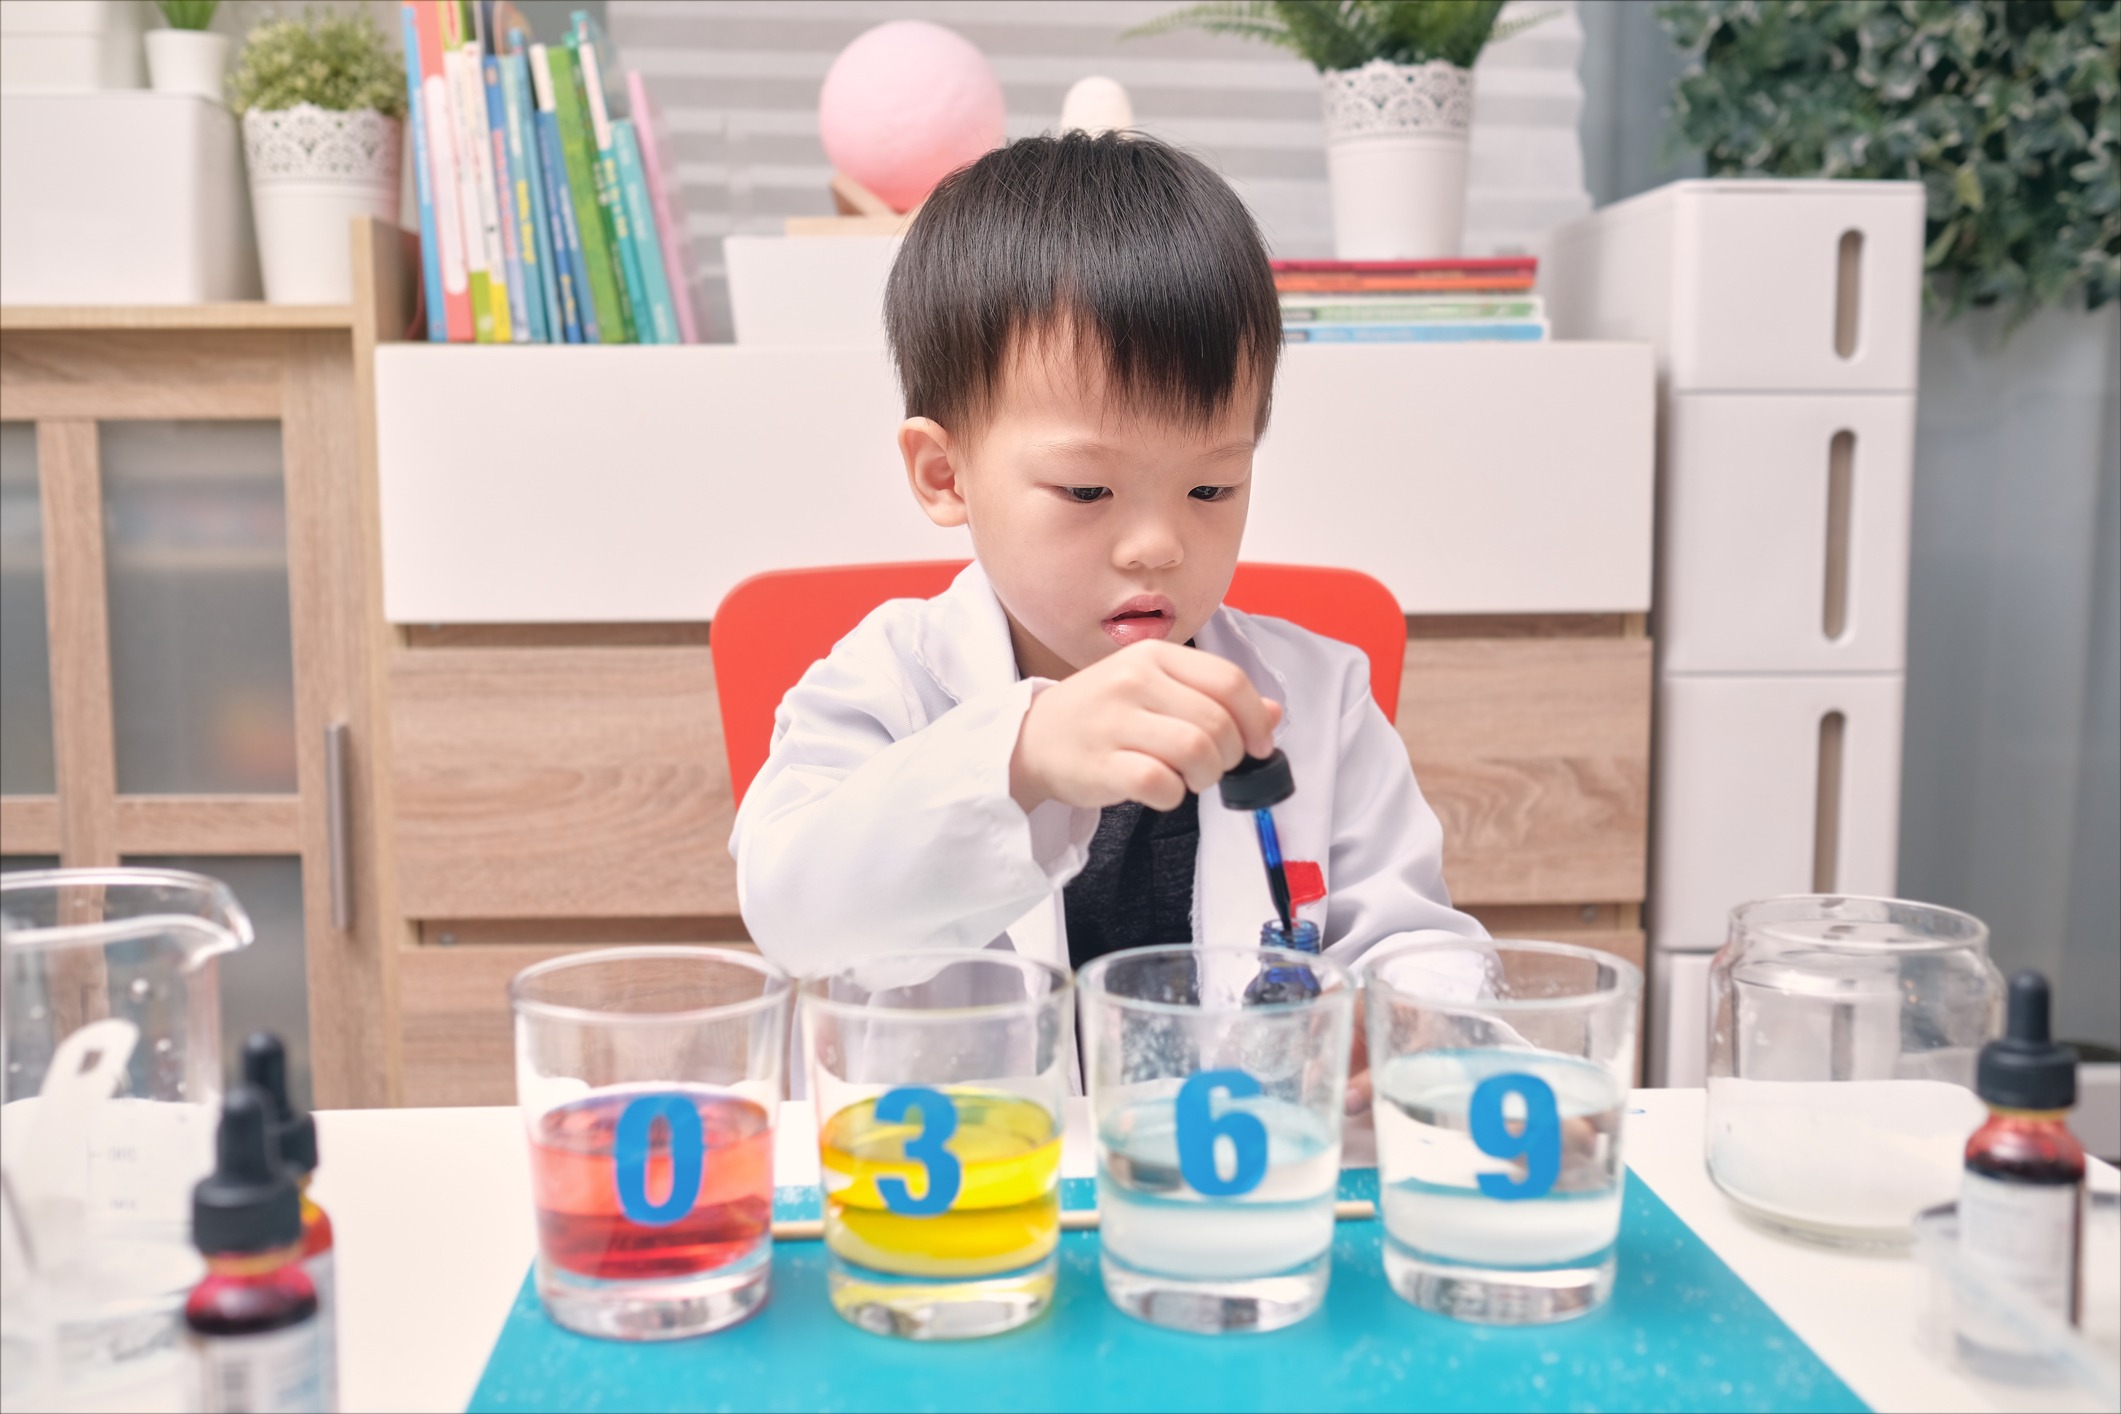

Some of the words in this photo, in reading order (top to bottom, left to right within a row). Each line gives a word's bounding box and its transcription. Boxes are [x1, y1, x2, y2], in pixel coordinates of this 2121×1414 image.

[615, 1094, 704, 1225] 0
[874, 1085, 962, 1217] 3
[1175, 1070, 1268, 1197] 6
[1469, 1073, 1561, 1200] 9
